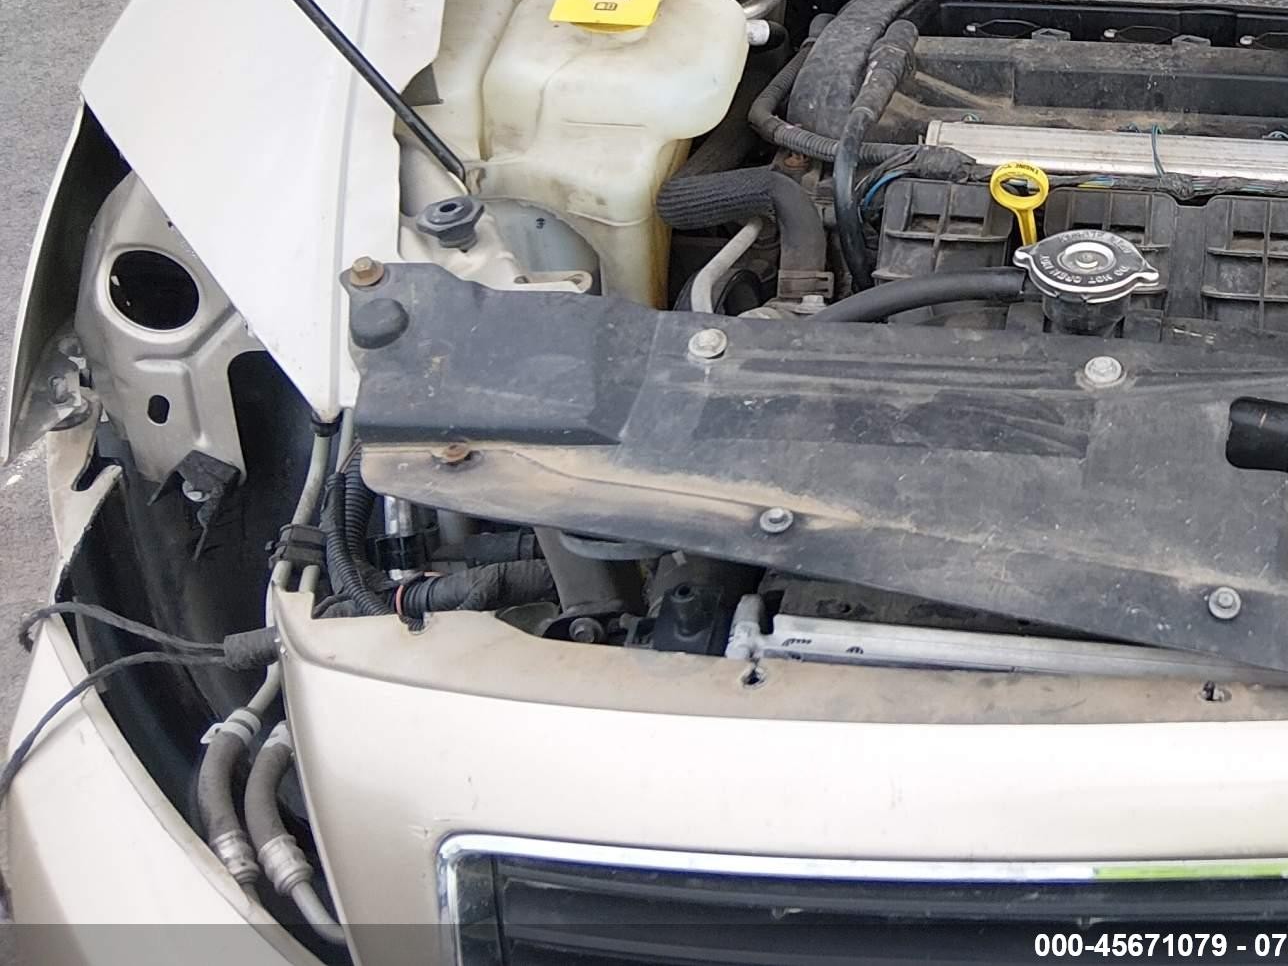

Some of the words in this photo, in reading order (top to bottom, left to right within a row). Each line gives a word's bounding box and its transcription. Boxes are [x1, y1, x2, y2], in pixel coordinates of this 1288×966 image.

[1049, 267, 1083, 284] OPEN
[1113, 265, 1130, 277] DO
[1087, 274, 1114, 285] NOT
